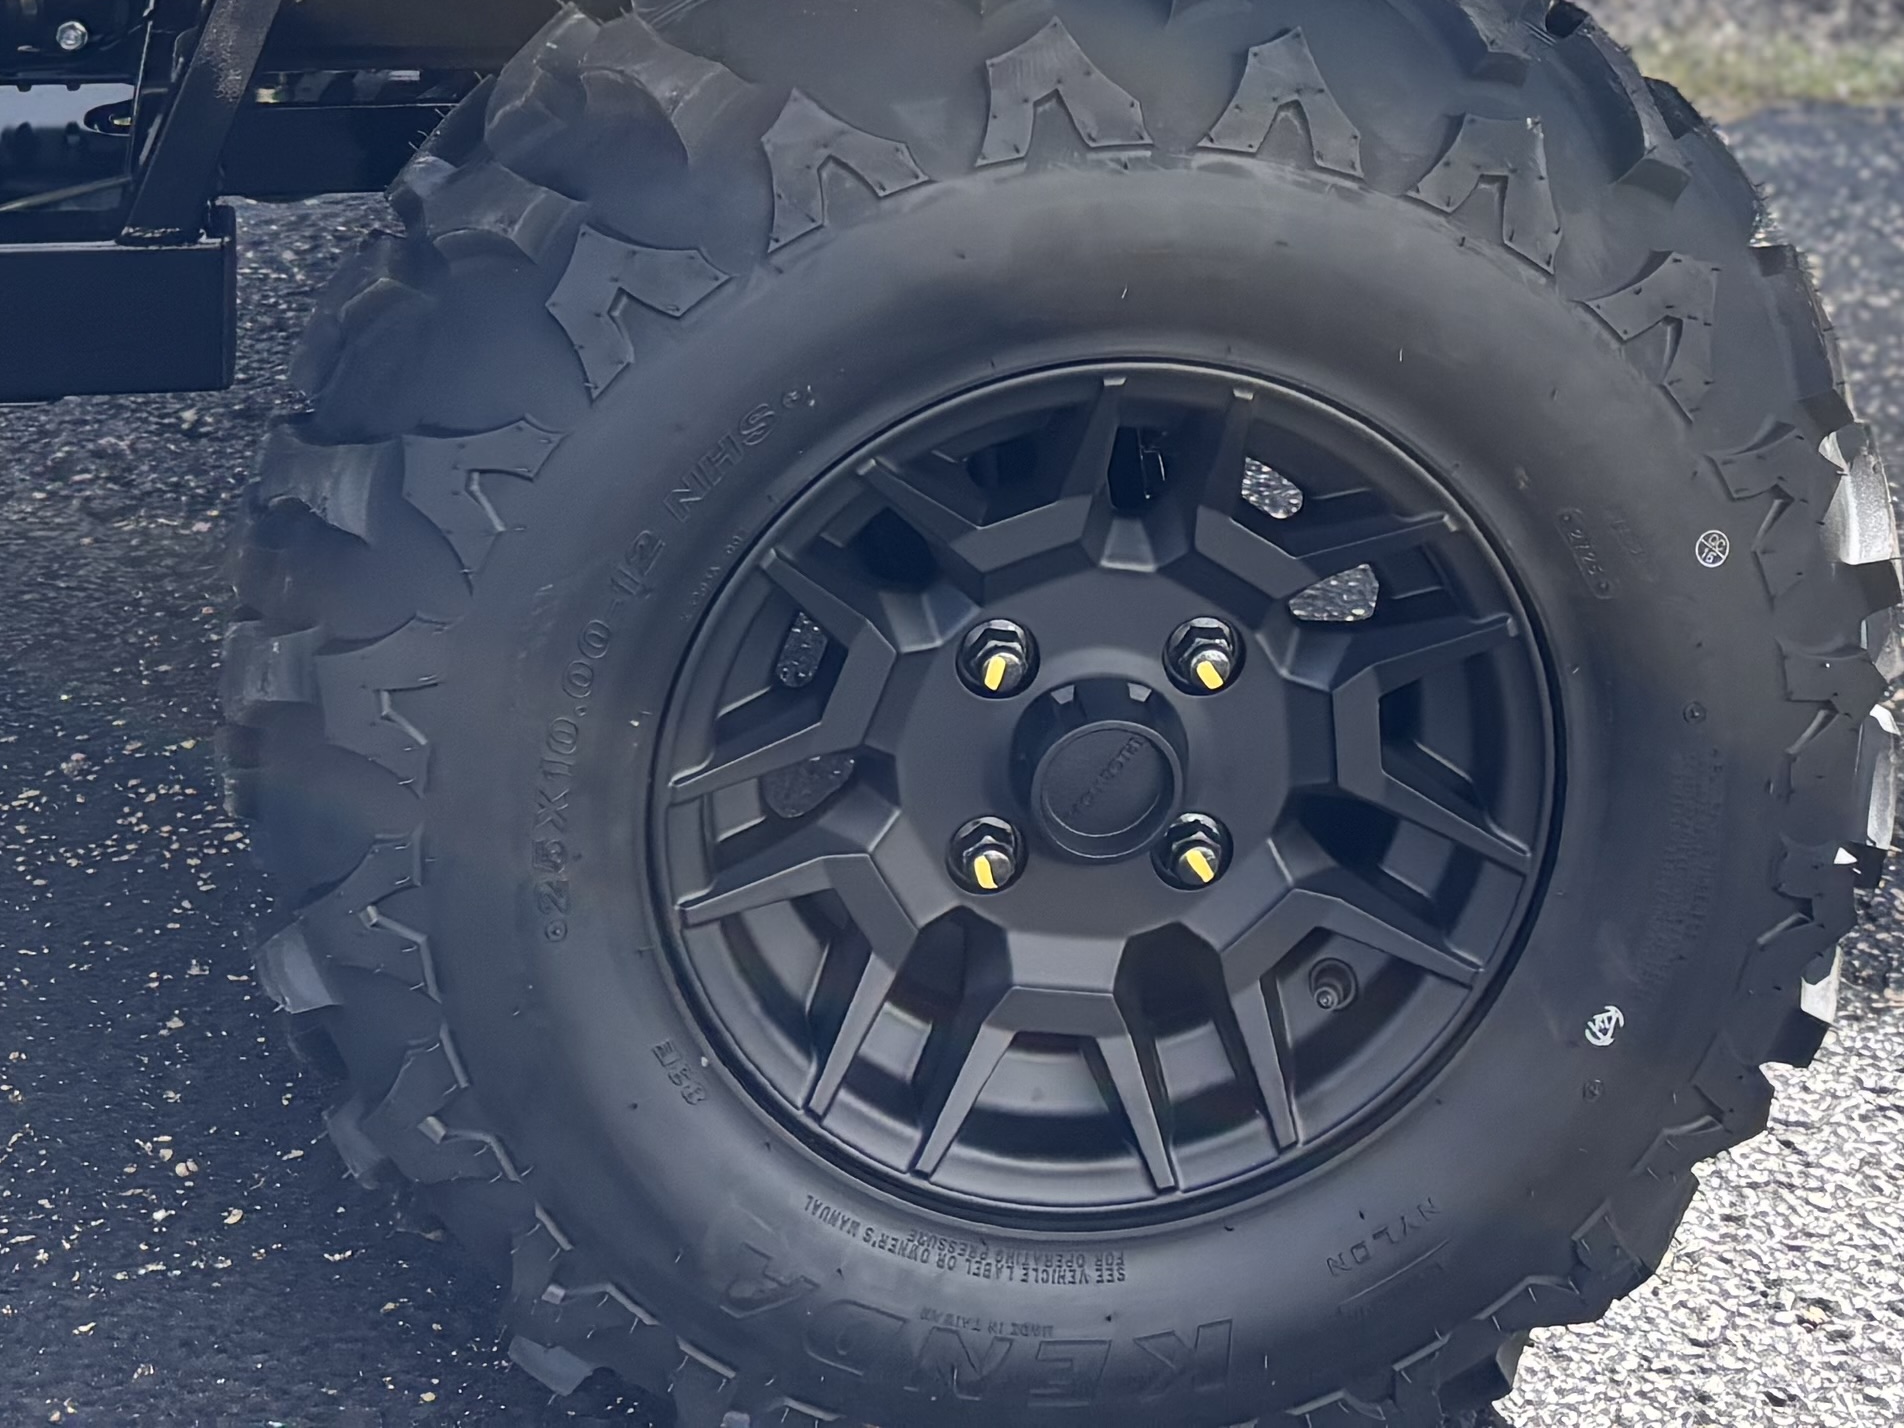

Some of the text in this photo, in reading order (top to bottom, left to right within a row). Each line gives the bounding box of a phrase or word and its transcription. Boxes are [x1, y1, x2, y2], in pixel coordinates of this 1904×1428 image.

[664, 402, 777, 526] NHS
[803, 1194, 1126, 1287] SEE VEHICLE LABEL OR OWNER'S MANUAL
[906, 1227, 989, 1265] PRESSURE
[1325, 1197, 1441, 1279] NYLON
[719, 1241, 1233, 1410] KENDA
